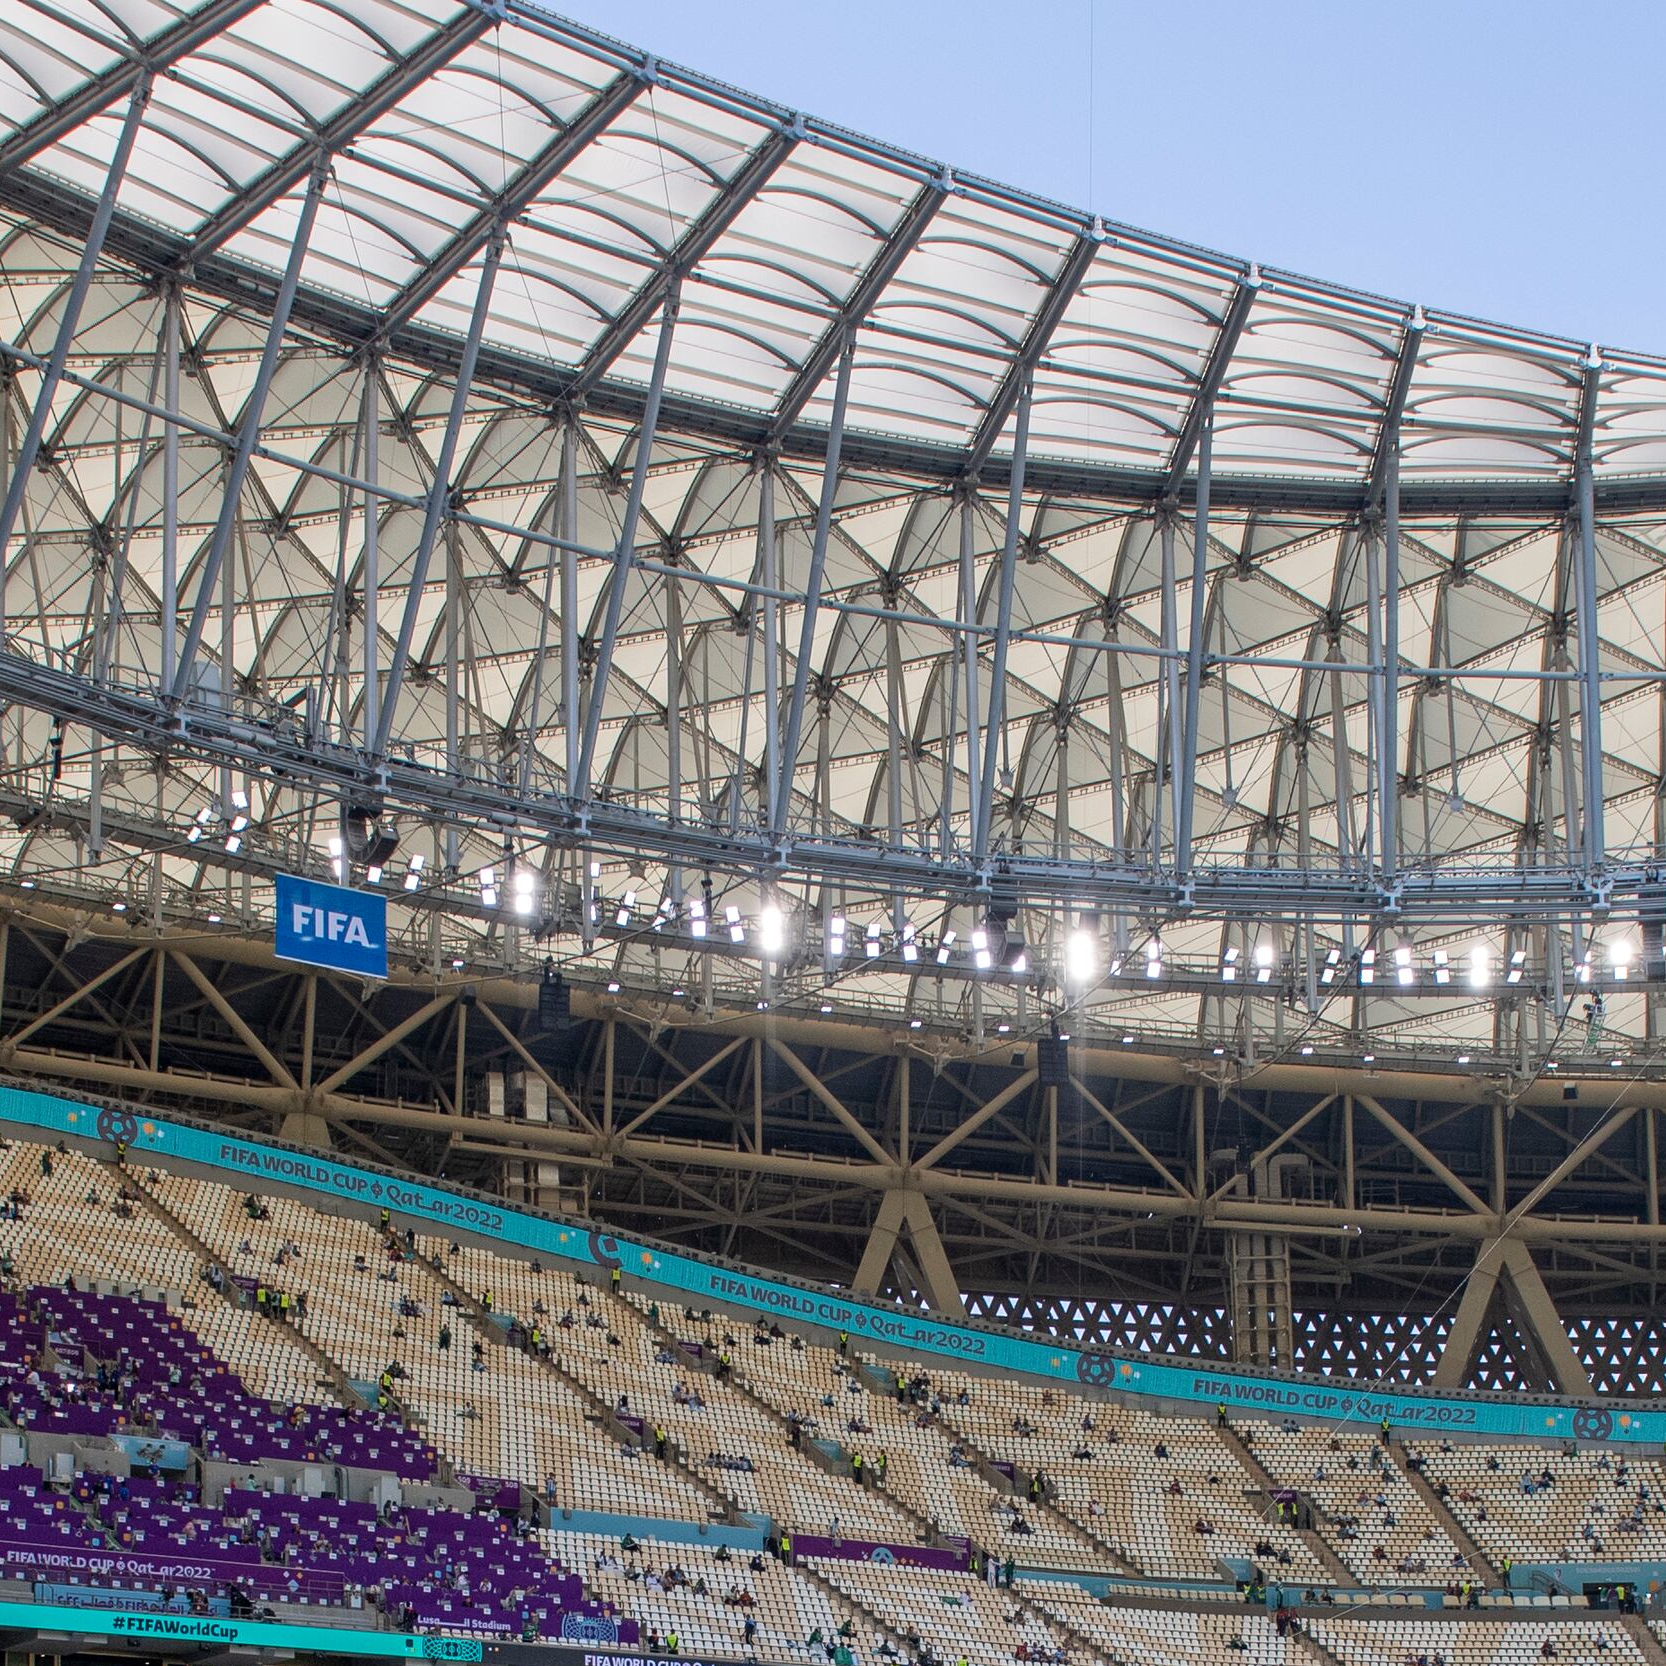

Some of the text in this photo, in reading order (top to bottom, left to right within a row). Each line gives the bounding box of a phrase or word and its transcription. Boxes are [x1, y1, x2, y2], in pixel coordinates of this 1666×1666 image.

[293, 903, 371, 948] FIFA
[220, 1144, 261, 1166] FIFA
[263, 1153, 331, 1182] WORLD
[331, 1171, 368, 1194] CUP
[709, 1275, 748, 1298] FIFA
[750, 1284, 815, 1315] WORLD
[817, 1302, 853, 1323] CUP
[1194, 1379, 1233, 1396] FIFA
[1234, 1383, 1302, 1408] WORLD
[1304, 1391, 1339, 1410] CUP
[7, 1550, 34, 1563] FIFA
[89, 1555, 114, 1569] CUP
[112, 1616, 239, 1640] #FIFAWorldCup
[472, 1619, 511, 1631] Stadium
